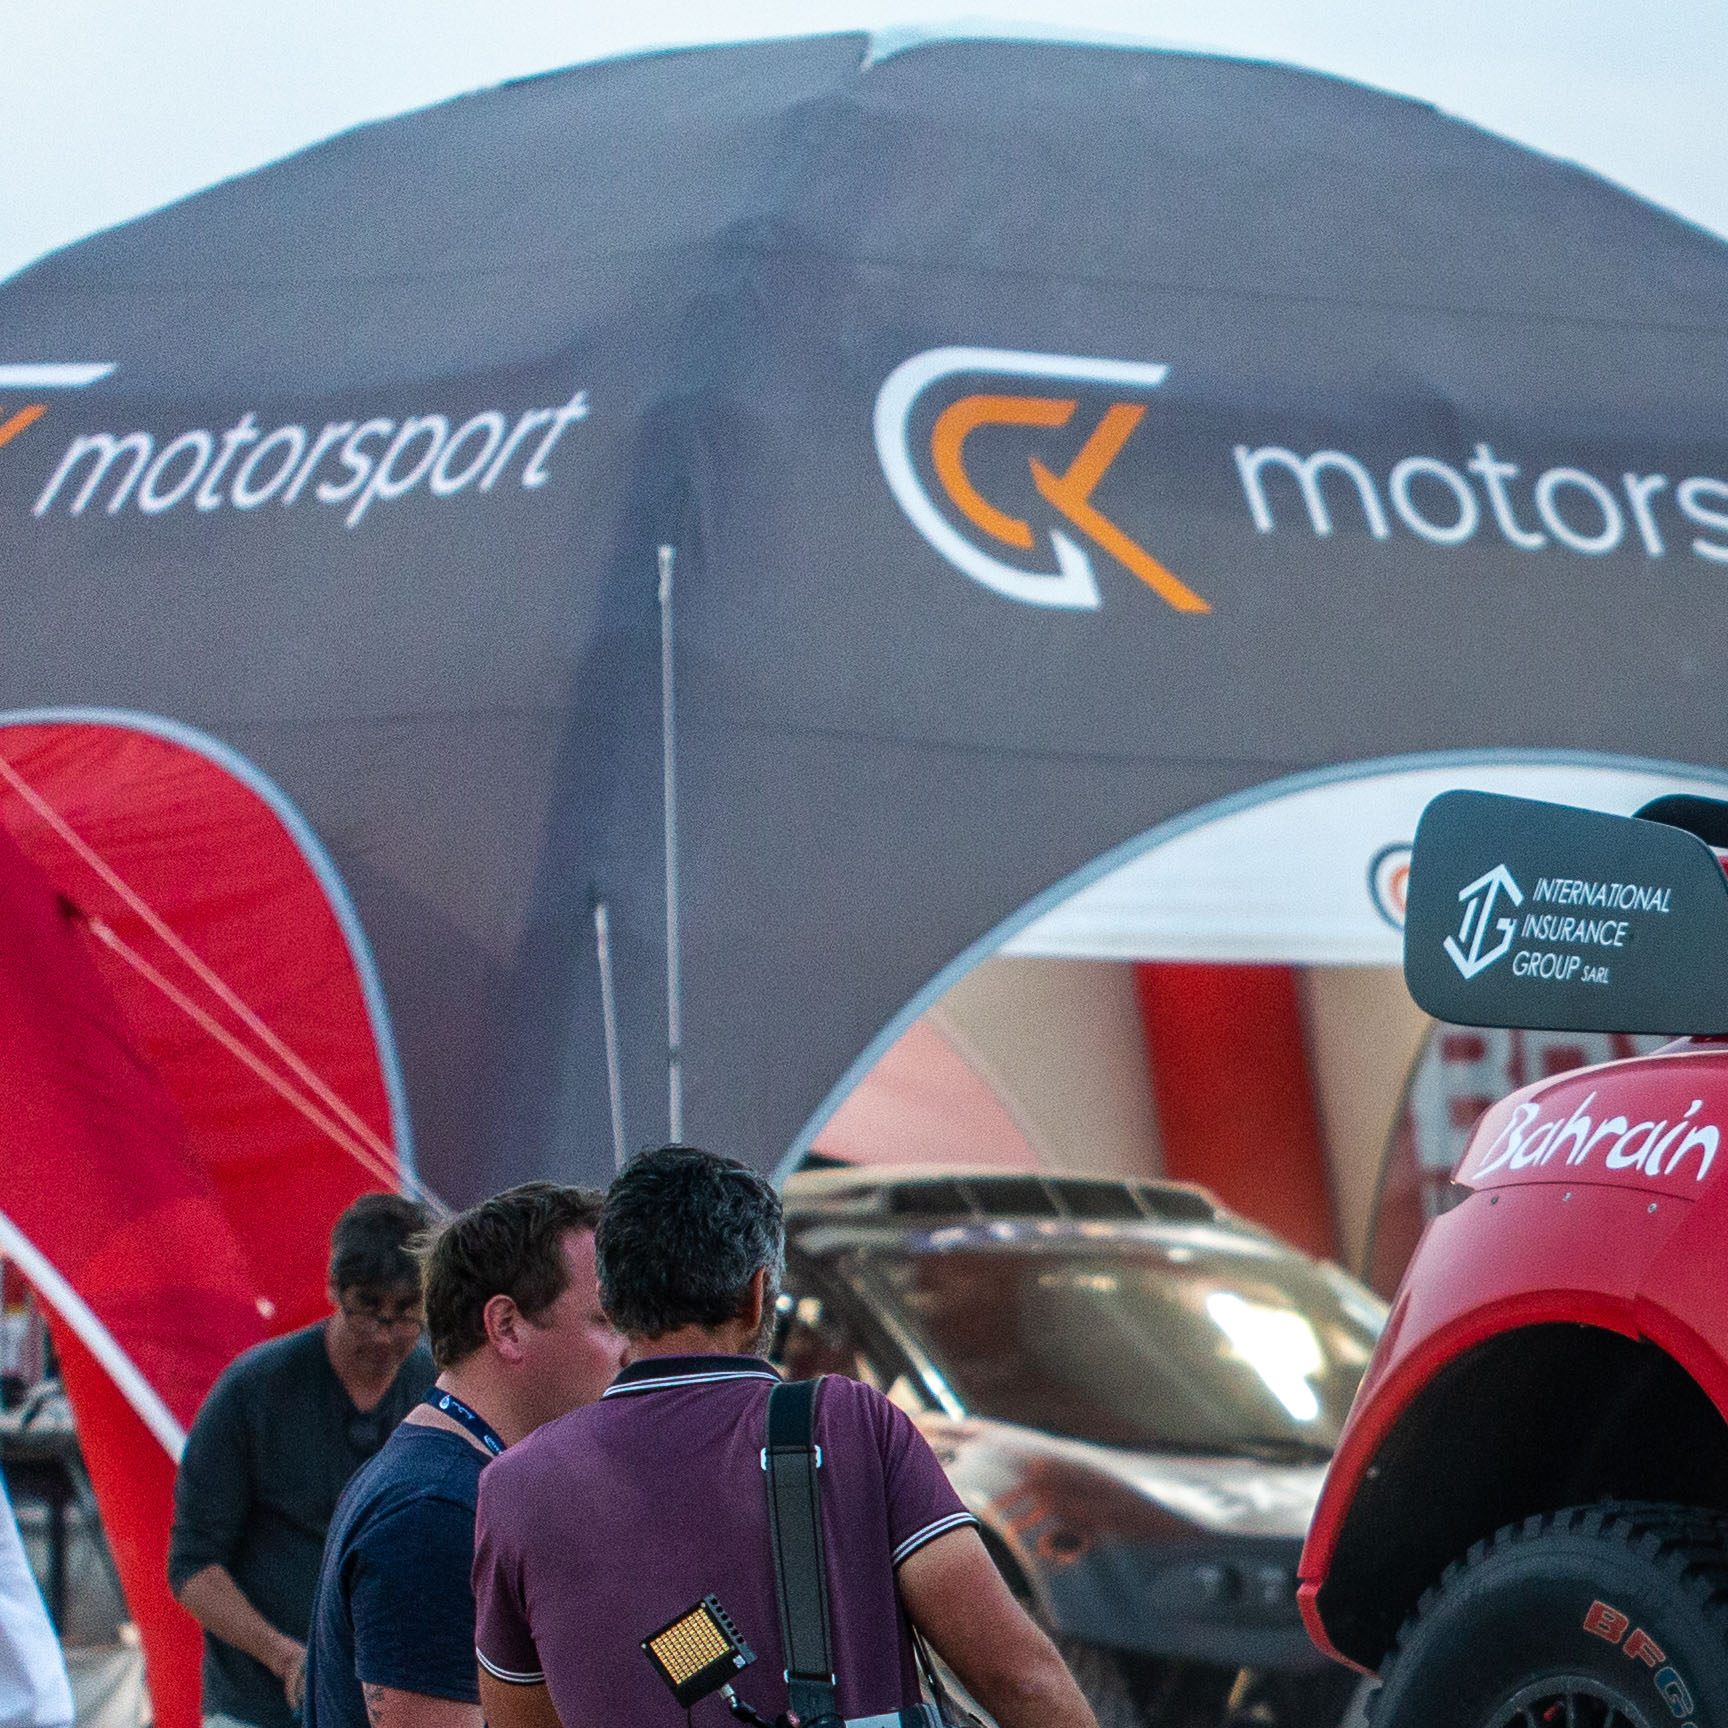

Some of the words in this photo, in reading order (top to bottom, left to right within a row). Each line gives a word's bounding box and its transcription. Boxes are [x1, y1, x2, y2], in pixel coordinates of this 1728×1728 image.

[32, 390, 590, 529] motorsport
[1532, 877, 1672, 913] INTERNATIONAL
[1521, 914, 1629, 947] INSURANCE
[1512, 950, 1581, 980] GROUP
[1581, 965, 1609, 984] SARL
[1472, 1091, 1720, 1181] Bahrain
